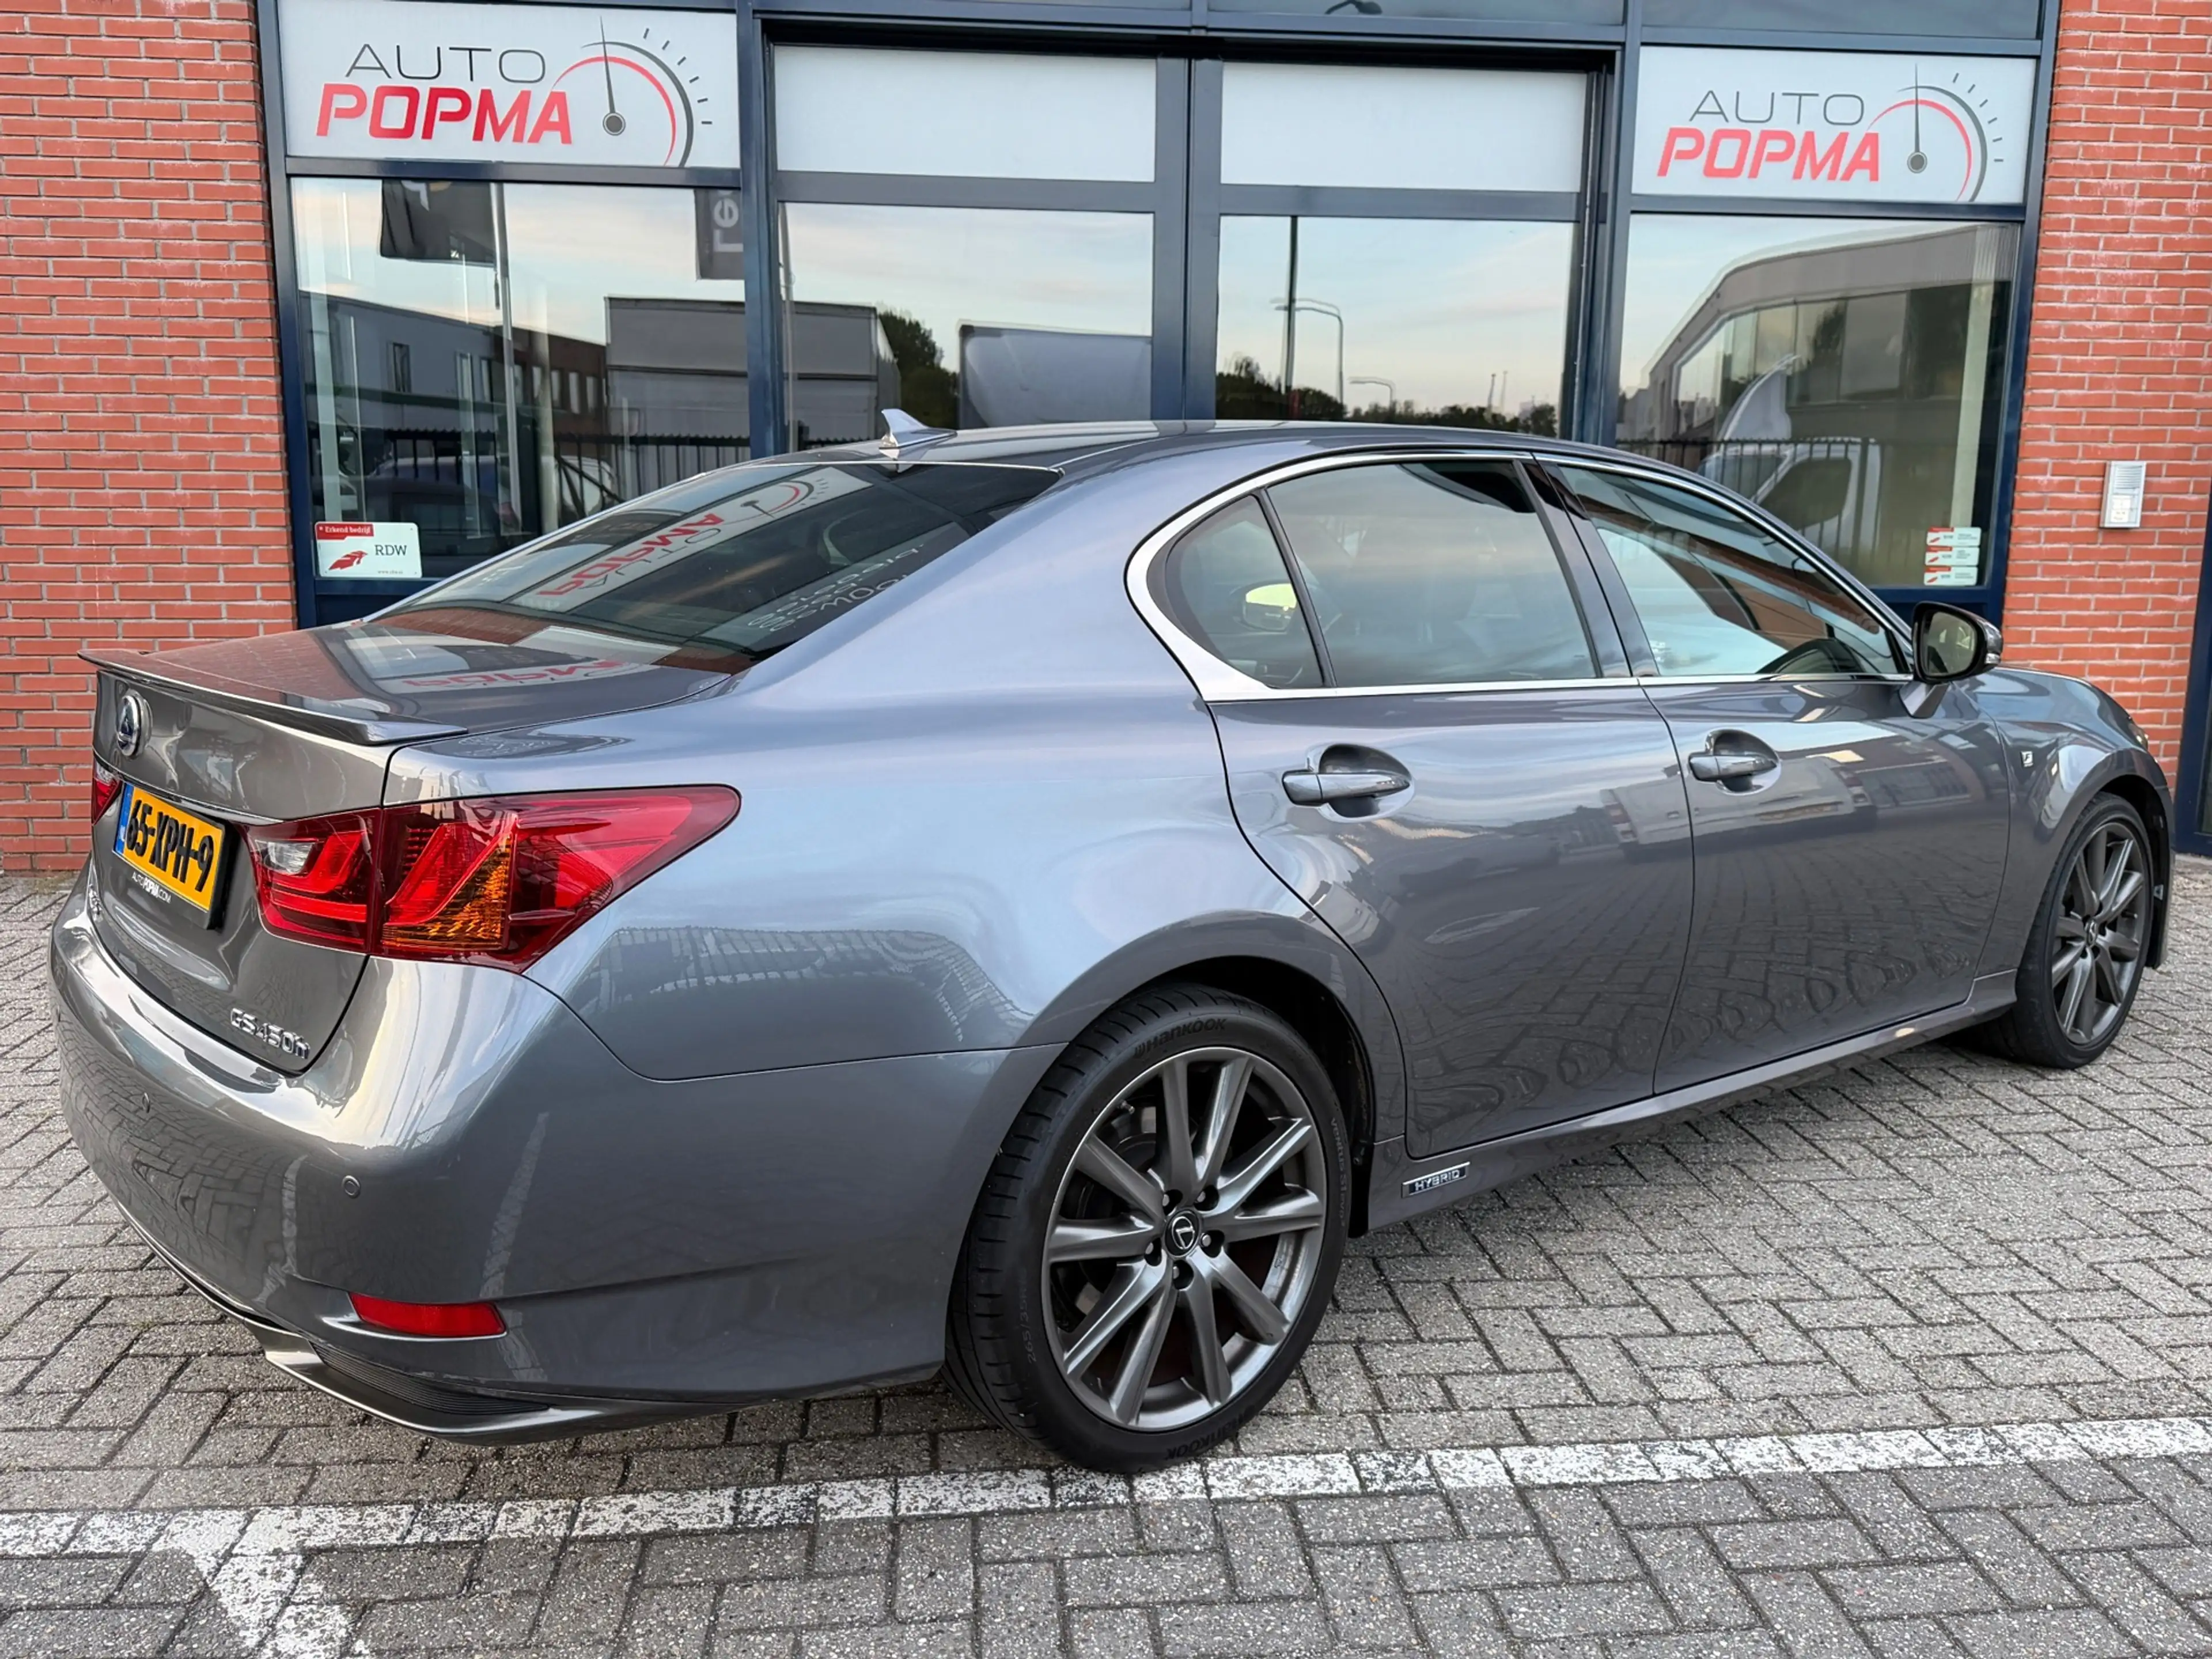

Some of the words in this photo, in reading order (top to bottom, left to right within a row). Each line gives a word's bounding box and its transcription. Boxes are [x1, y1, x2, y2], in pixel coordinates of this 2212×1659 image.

[345, 43, 546, 84] AUTO
[316, 83, 573, 145] POPMA
[1688, 90, 1865, 126] AUTO
[1656, 127, 1880, 182] POPMA
[324, 525, 348, 533] Erkend
[349, 527, 371, 535] bedrijf
[374, 544, 407, 556] RDW
[126, 799, 214, 893] 65-XPH-9
[230, 1007, 258, 1036] GS
[256, 1022, 310, 1059] 450h
[1414, 1169, 1460, 1191] HYBRID
